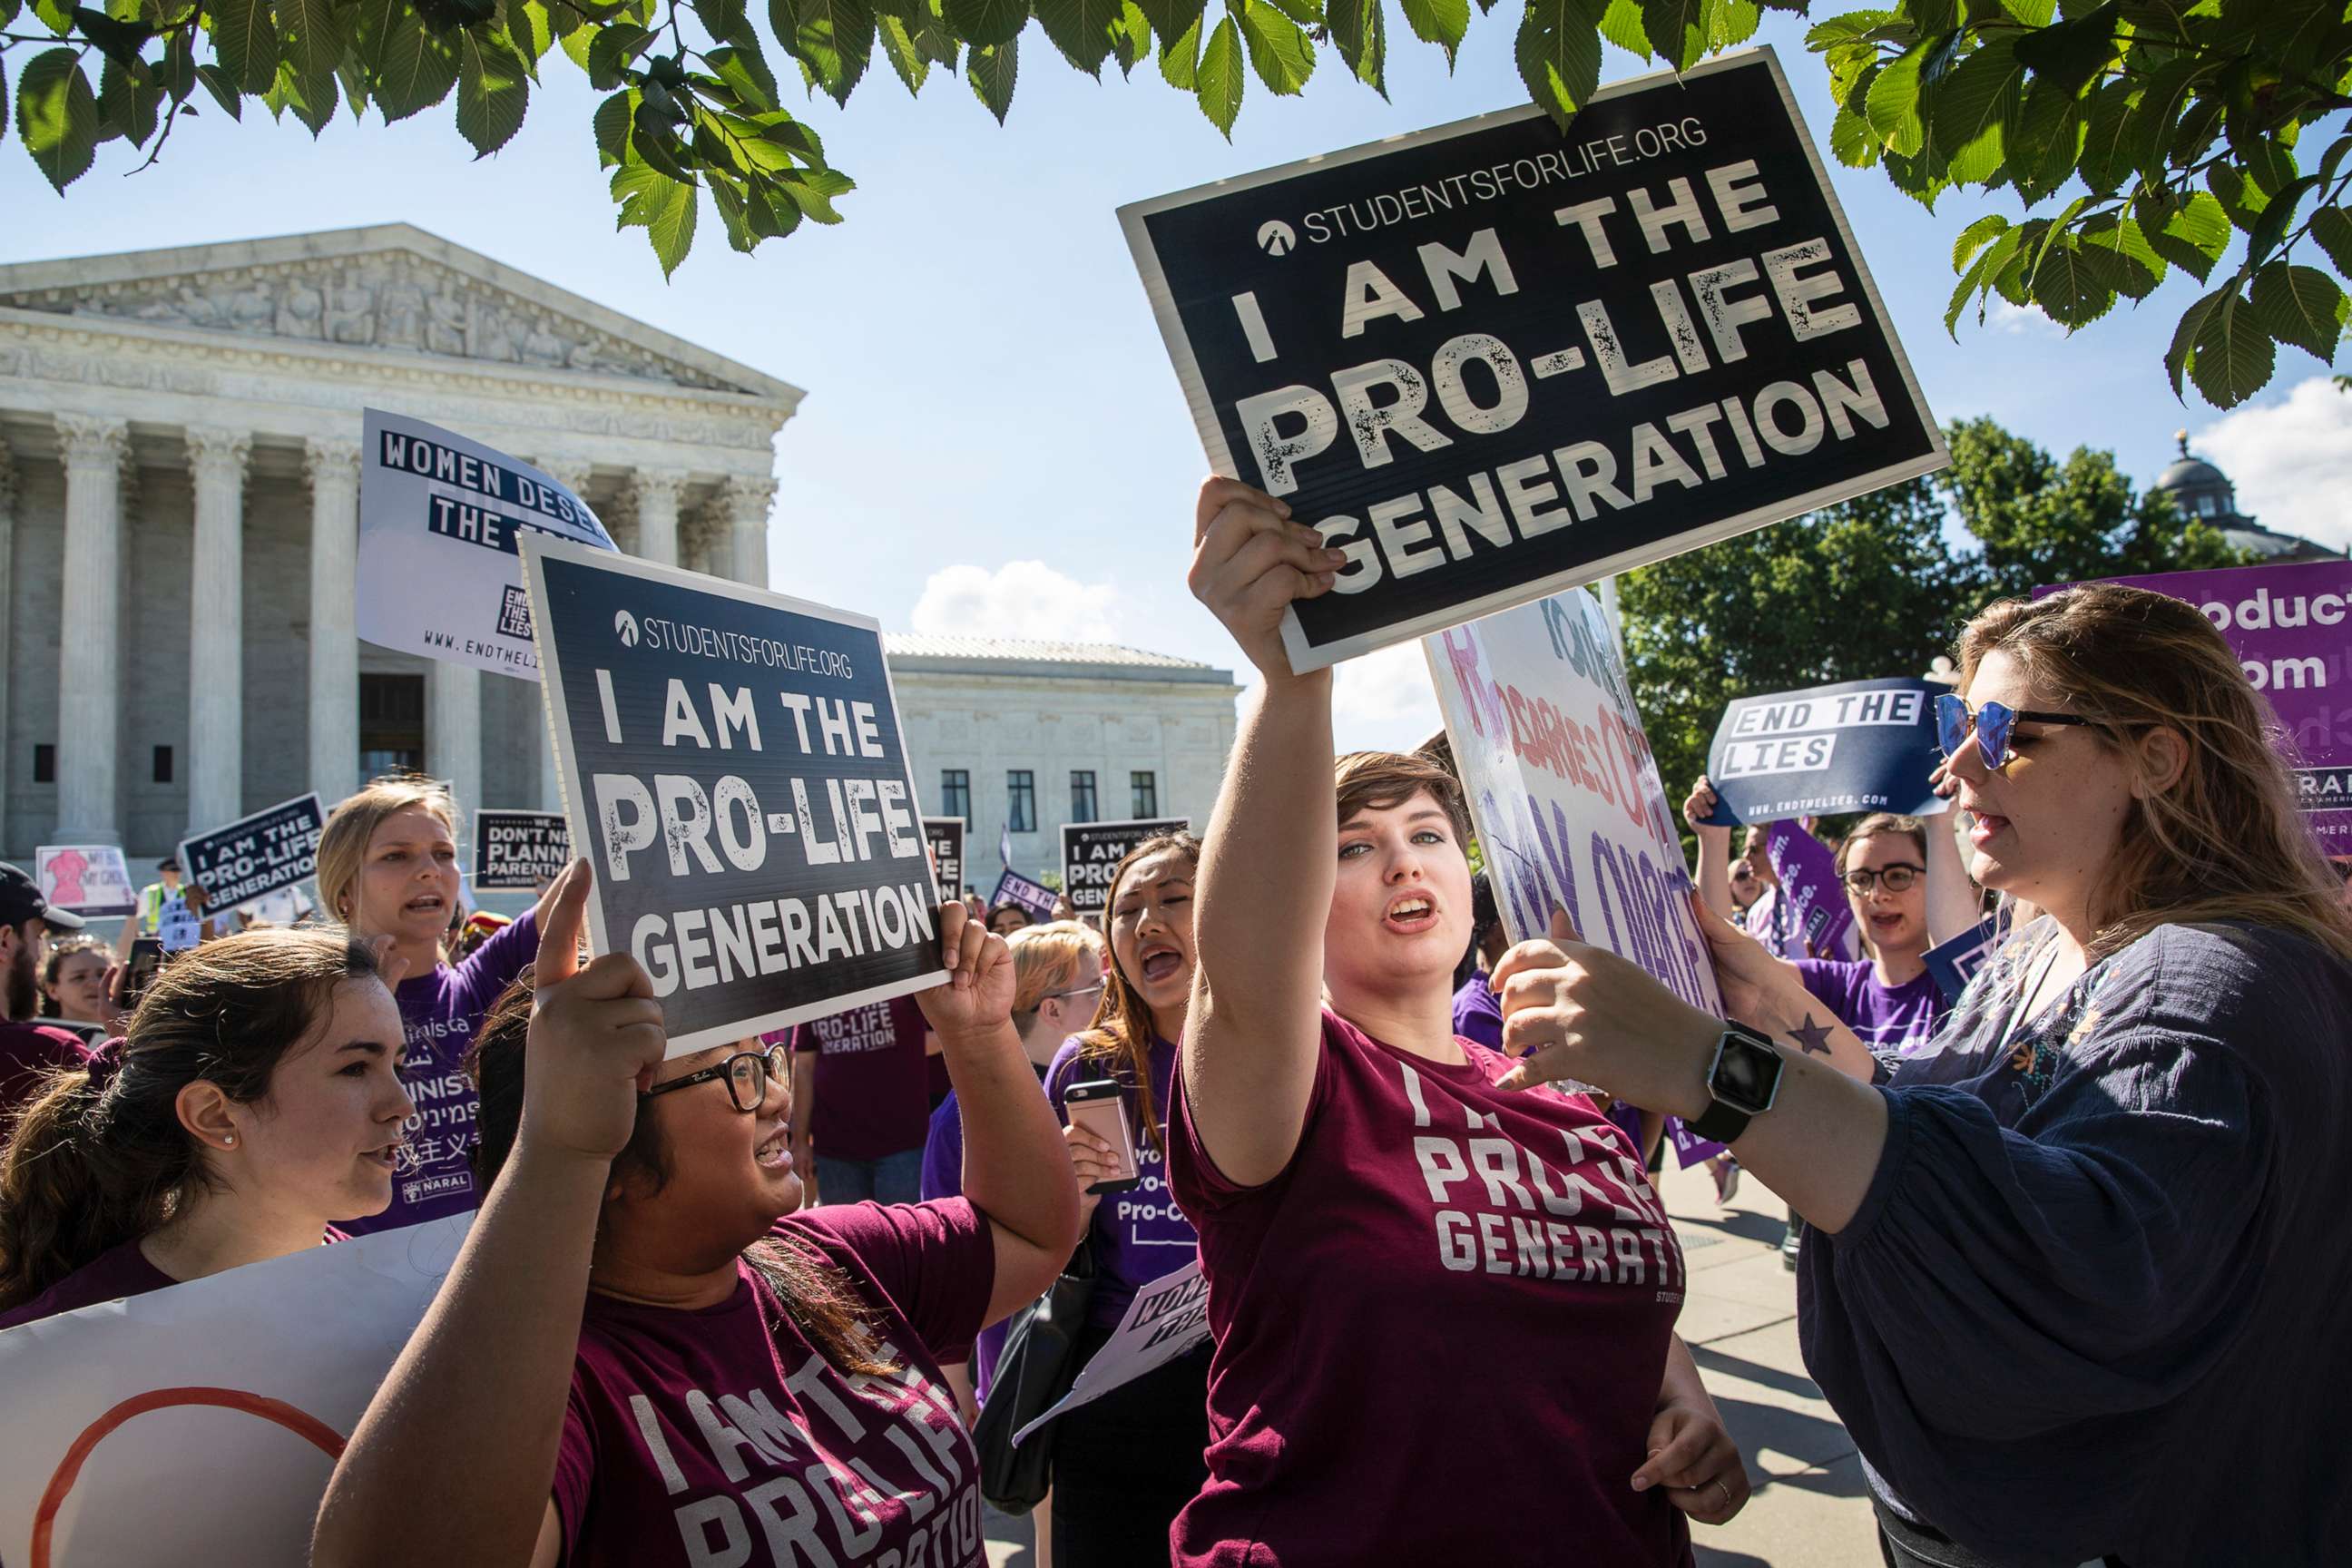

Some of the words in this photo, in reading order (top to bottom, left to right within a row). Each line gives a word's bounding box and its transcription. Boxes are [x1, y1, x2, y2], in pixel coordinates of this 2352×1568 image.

[1304, 117, 1708, 246] STUDENTSFORLIFE.ORG
[1231, 290, 1278, 363] I
[1342, 227, 1521, 338] AM
[1555, 158, 1781, 270] THE
[1235, 236, 1865, 496] PRO-LIFE
[385, 433, 502, 497] WOMEN
[517, 475, 611, 544] DESE
[1320, 358, 1891, 595] GENERATION
[436, 498, 501, 549] THE
[500, 616, 532, 637] LIES
[505, 603, 528, 622] THE
[645, 617, 853, 681] STUDENTSFORLIFE.ORG
[594, 668, 623, 745] I
[662, 677, 763, 752] AM
[780, 691, 885, 759] THE
[1735, 702, 1813, 734] END
[1836, 692, 1917, 724] THE
[1724, 737, 1828, 774] LIES
[488, 827, 544, 842] DON'T
[592, 774, 920, 882] PRO-LIFE
[1748, 793, 1888, 818] WWW.ENDTHELIES.COM
[196, 827, 321, 889] PRO-LIFE
[198, 854, 208, 870] I
[218, 836, 256, 863] AM
[263, 814, 313, 843] THE
[1073, 845, 1081, 861] I
[1090, 843, 1126, 860] AM
[1004, 877, 1032, 897] END
[631, 881, 936, 998] GENERATION
[1398, 1059, 1431, 1128] I
[423, 1176, 467, 1191] NARAL
[629, 1394, 689, 1496] I
[685, 1387, 810, 1484] AM
